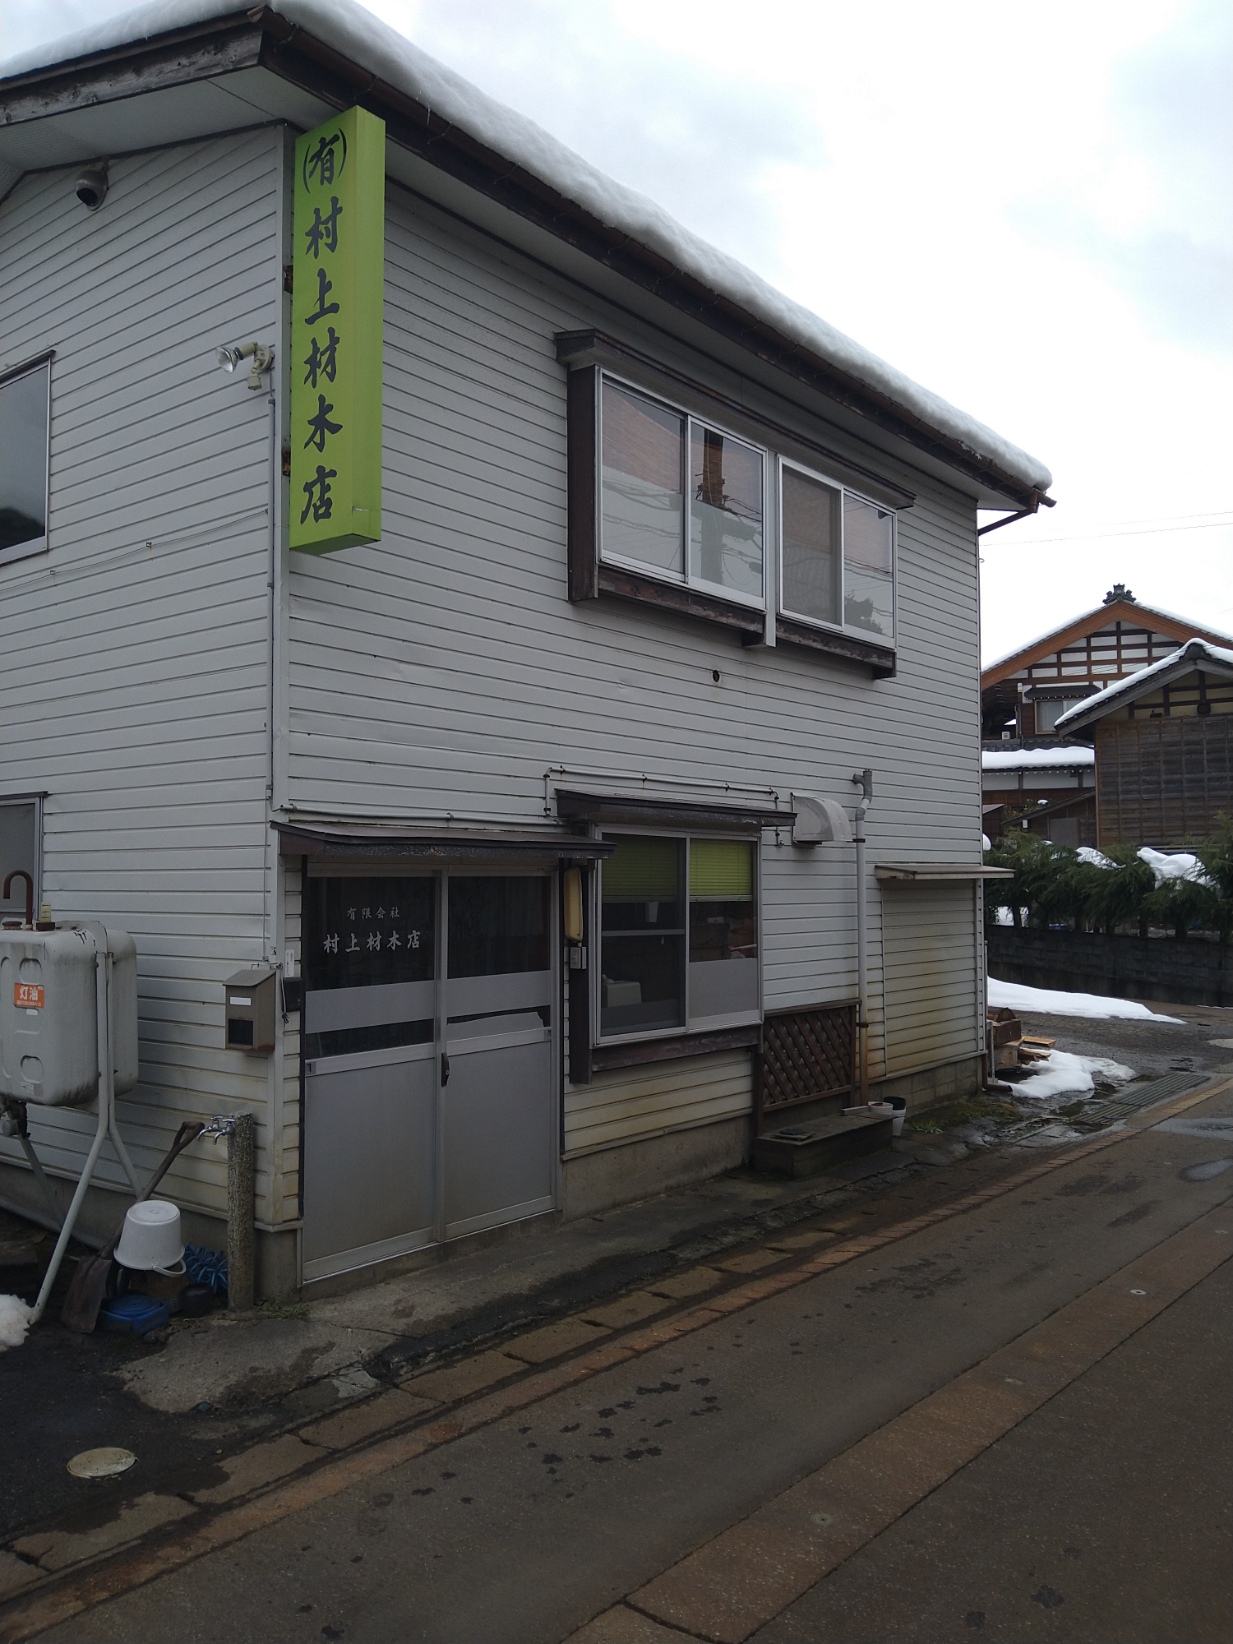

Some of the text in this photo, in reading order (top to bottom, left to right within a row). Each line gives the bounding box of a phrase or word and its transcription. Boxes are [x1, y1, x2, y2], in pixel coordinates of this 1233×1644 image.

[299, 126, 348, 526] (有)村上材木店
[346, 906, 401, 920] 有限会社
[323, 930, 421, 954] 村上材木店
[19, 985, 39, 1001] 灯油
